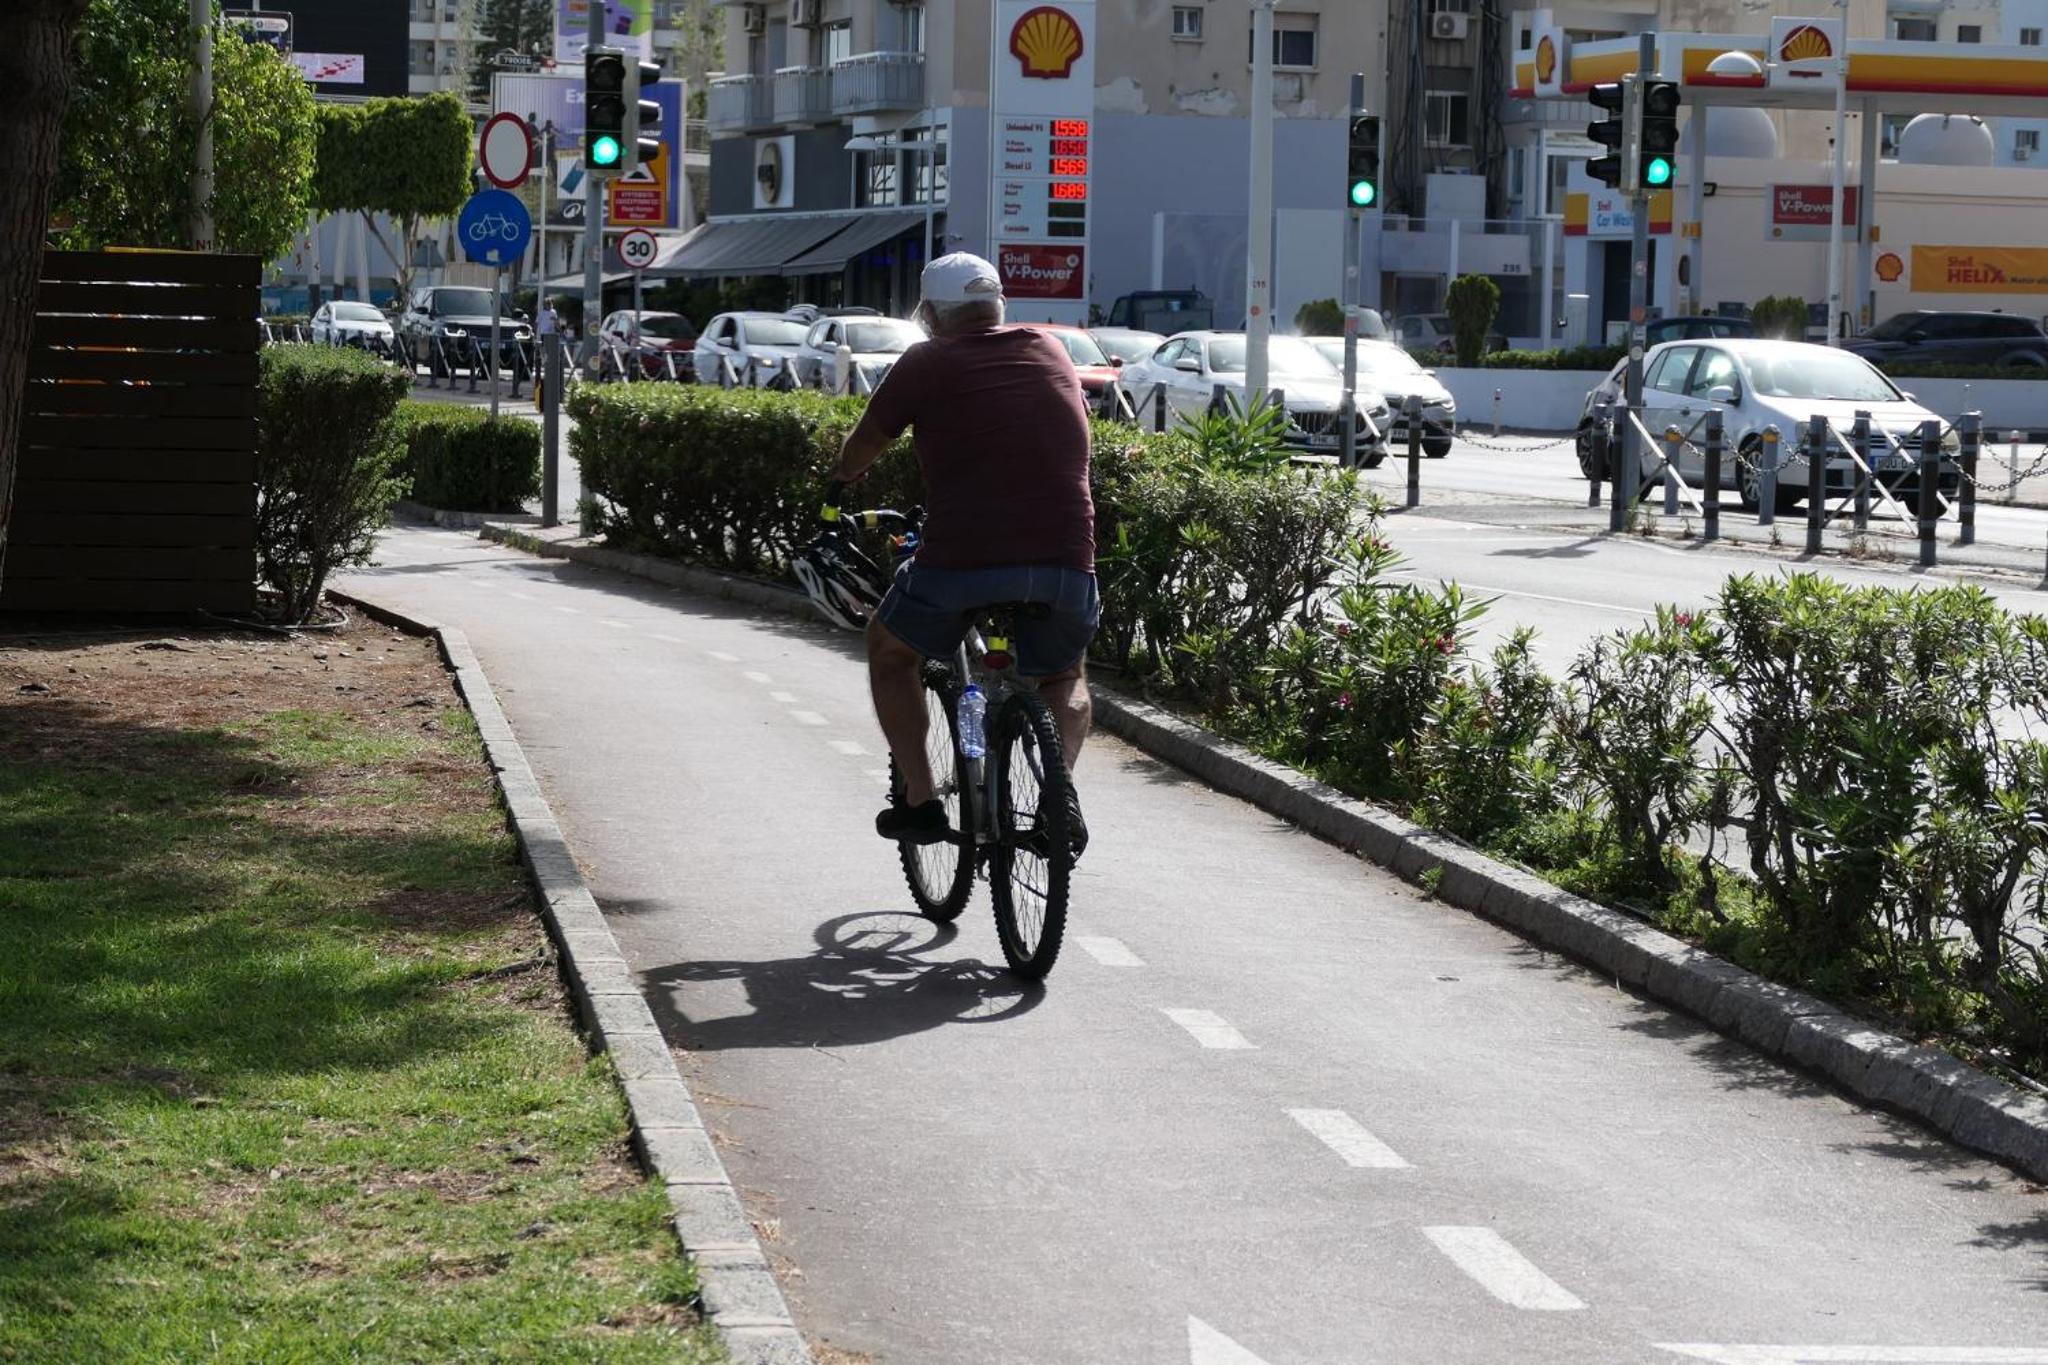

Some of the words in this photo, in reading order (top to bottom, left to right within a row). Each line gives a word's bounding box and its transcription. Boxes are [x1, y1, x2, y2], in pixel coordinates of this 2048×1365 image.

[1780, 200, 1834, 213] V-Powe
[1613, 213, 1633, 227] Was
[626, 241, 650, 257] 30
[1004, 253, 1030, 264] Shell
[1947, 256, 1974, 267] Shell
[1004, 265, 1074, 280] V-Power
[1947, 266, 2007, 284] HELIX
